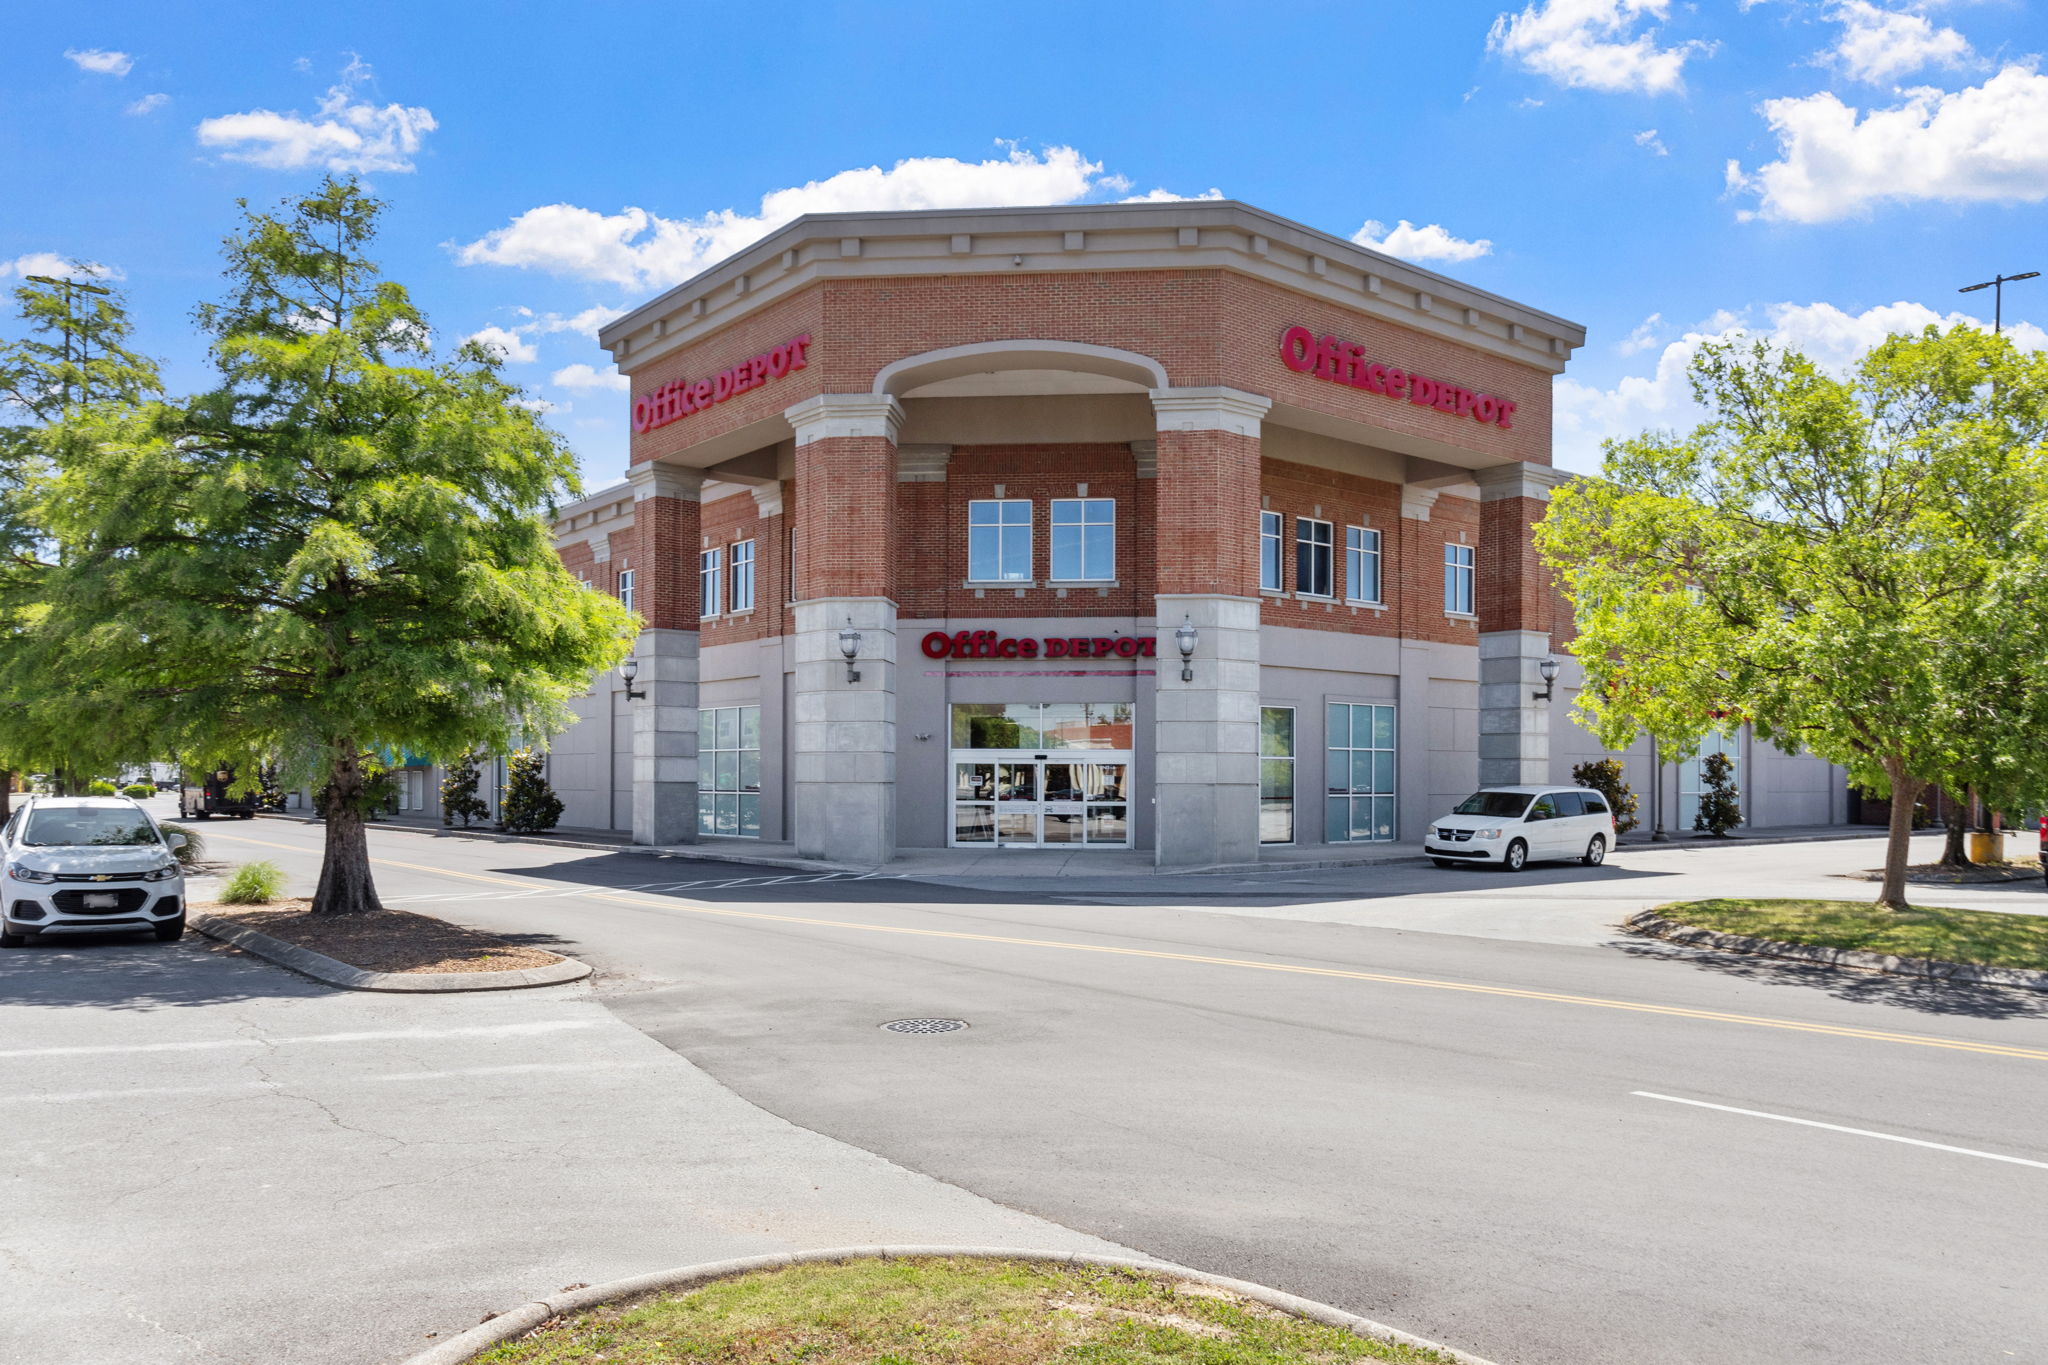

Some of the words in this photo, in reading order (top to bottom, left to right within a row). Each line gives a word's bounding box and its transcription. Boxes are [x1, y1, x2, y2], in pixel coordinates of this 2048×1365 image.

[632, 377, 714, 435] Office
[712, 334, 812, 402] DEPOT
[1280, 325, 1406, 399] Office
[1407, 373, 1518, 429] DEPOT
[921, 630, 1039, 659] Office
[1043, 637, 1156, 658] DEPOT
